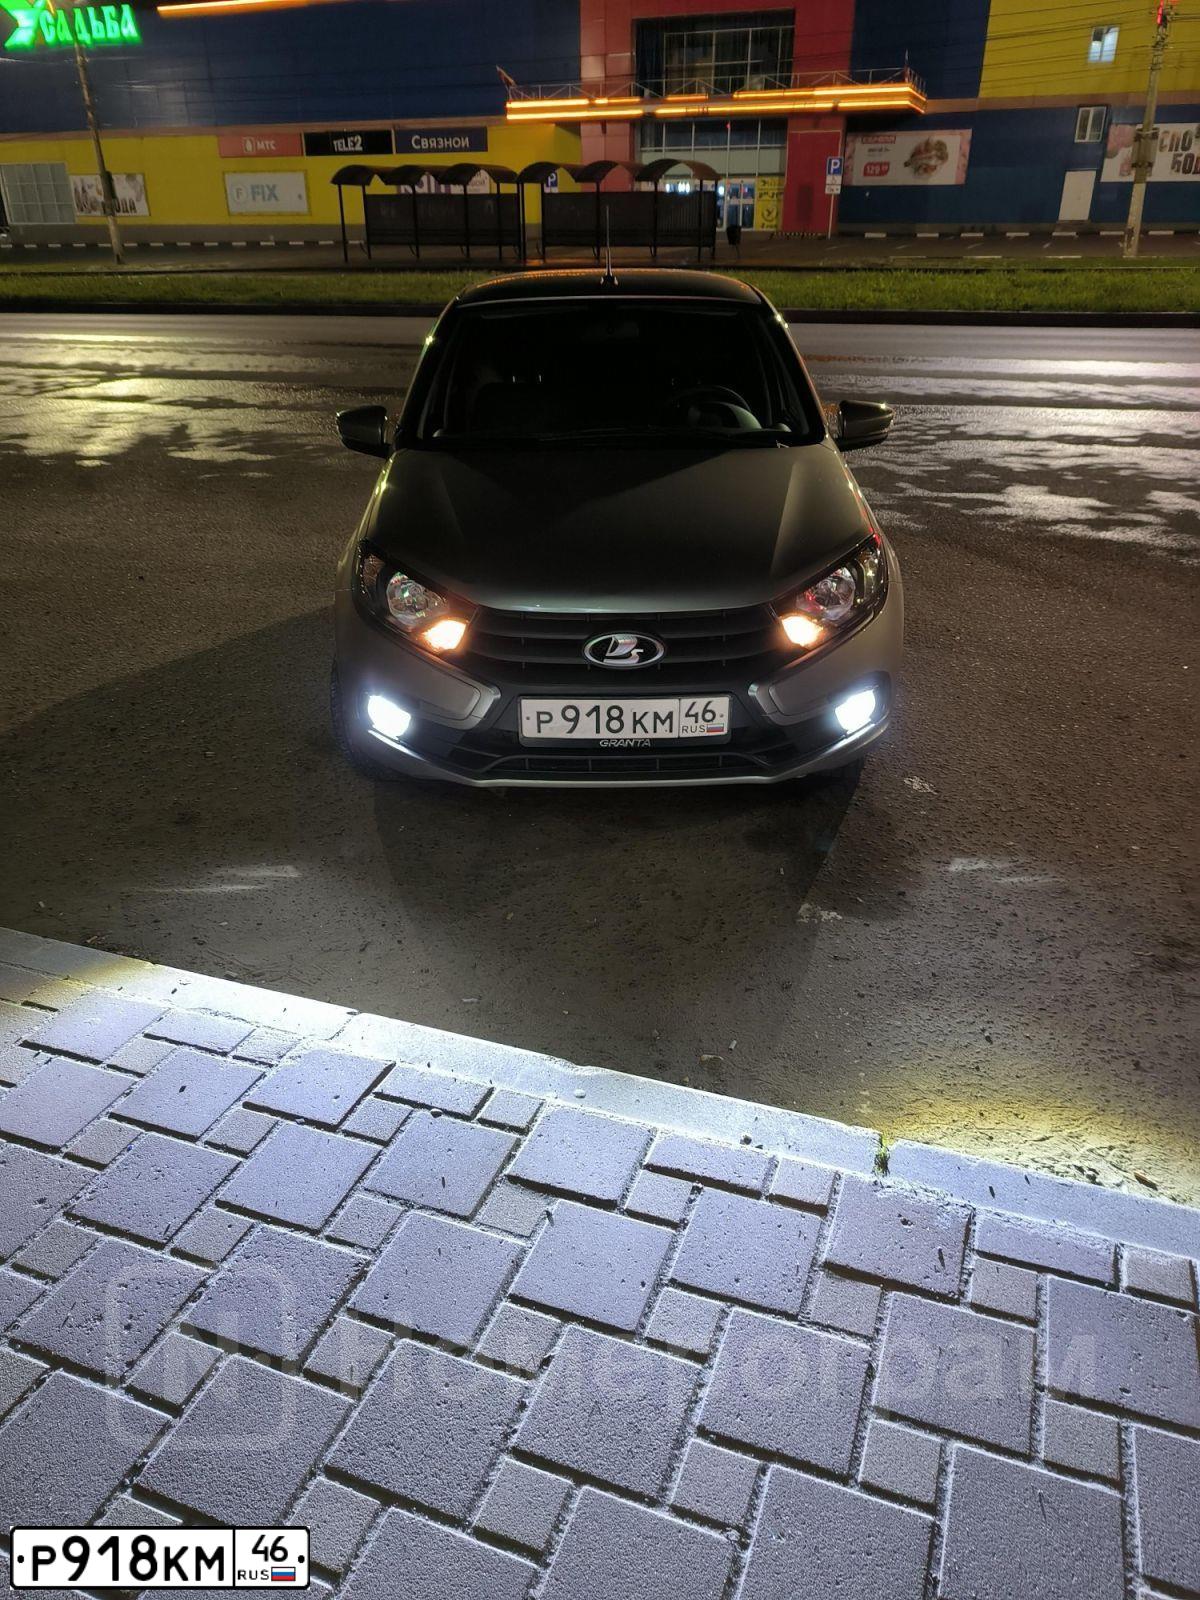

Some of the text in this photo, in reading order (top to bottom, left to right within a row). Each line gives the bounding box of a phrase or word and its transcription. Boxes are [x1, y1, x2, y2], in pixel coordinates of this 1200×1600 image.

[333, 135, 363, 152] TELE2
[831, 159, 841, 174] P
[535, 700, 717, 734] Р918КМ 46
[681, 724, 706, 735] RUS
[599, 738, 652, 748] GRANTA
